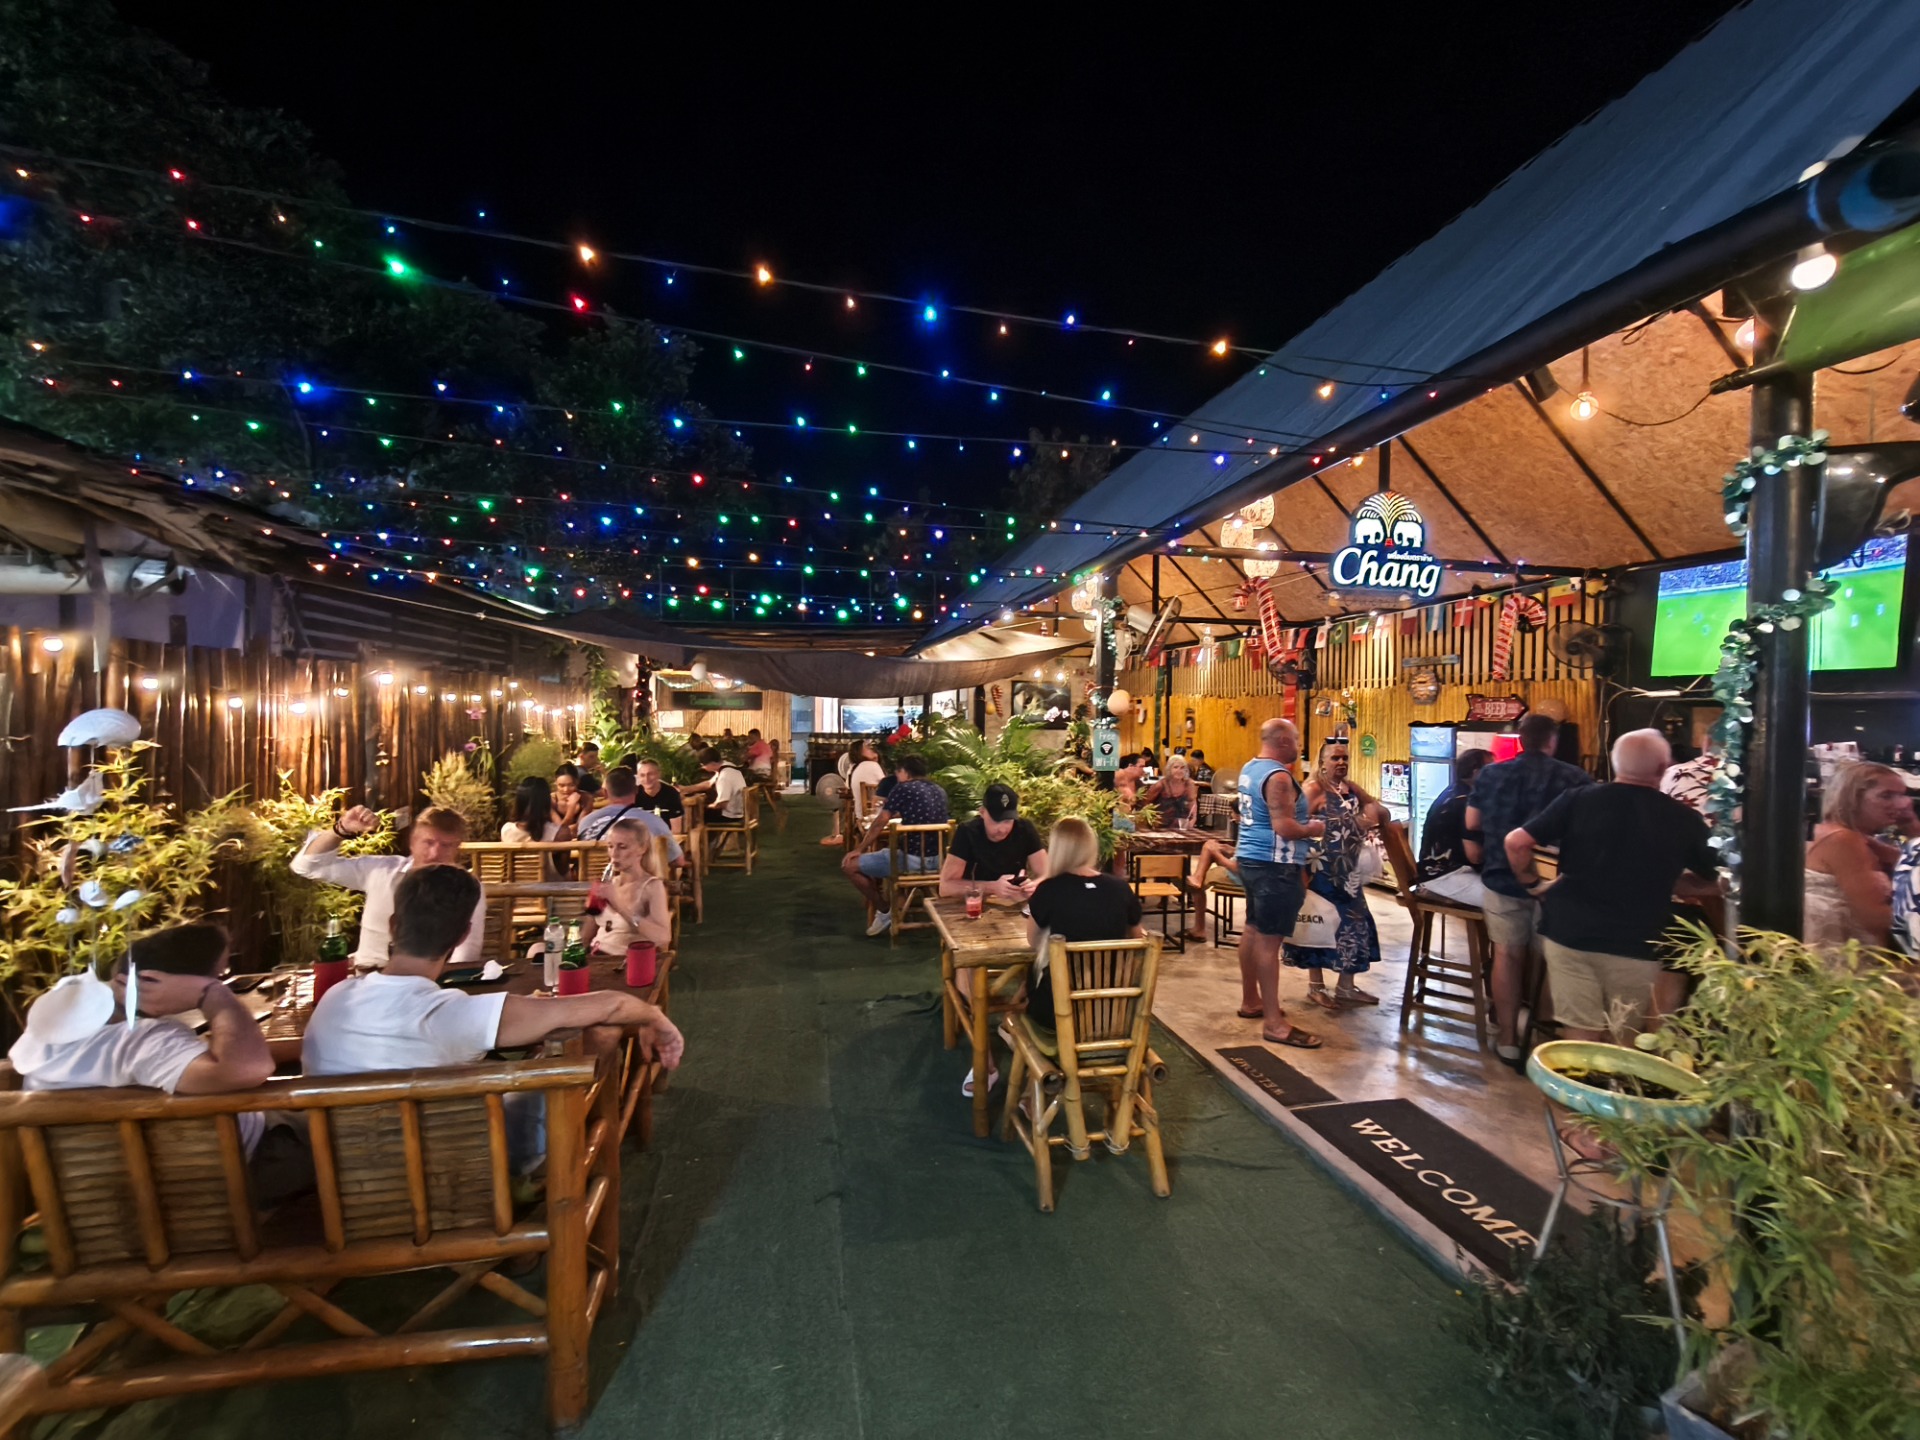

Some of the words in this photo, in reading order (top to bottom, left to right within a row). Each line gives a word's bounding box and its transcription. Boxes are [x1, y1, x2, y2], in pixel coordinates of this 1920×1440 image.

[1333, 547, 1441, 597] Chang
[1485, 702, 1507, 715] BEER
[1099, 731, 1117, 740] Free
[1351, 1118, 1538, 1251] WELCOME
